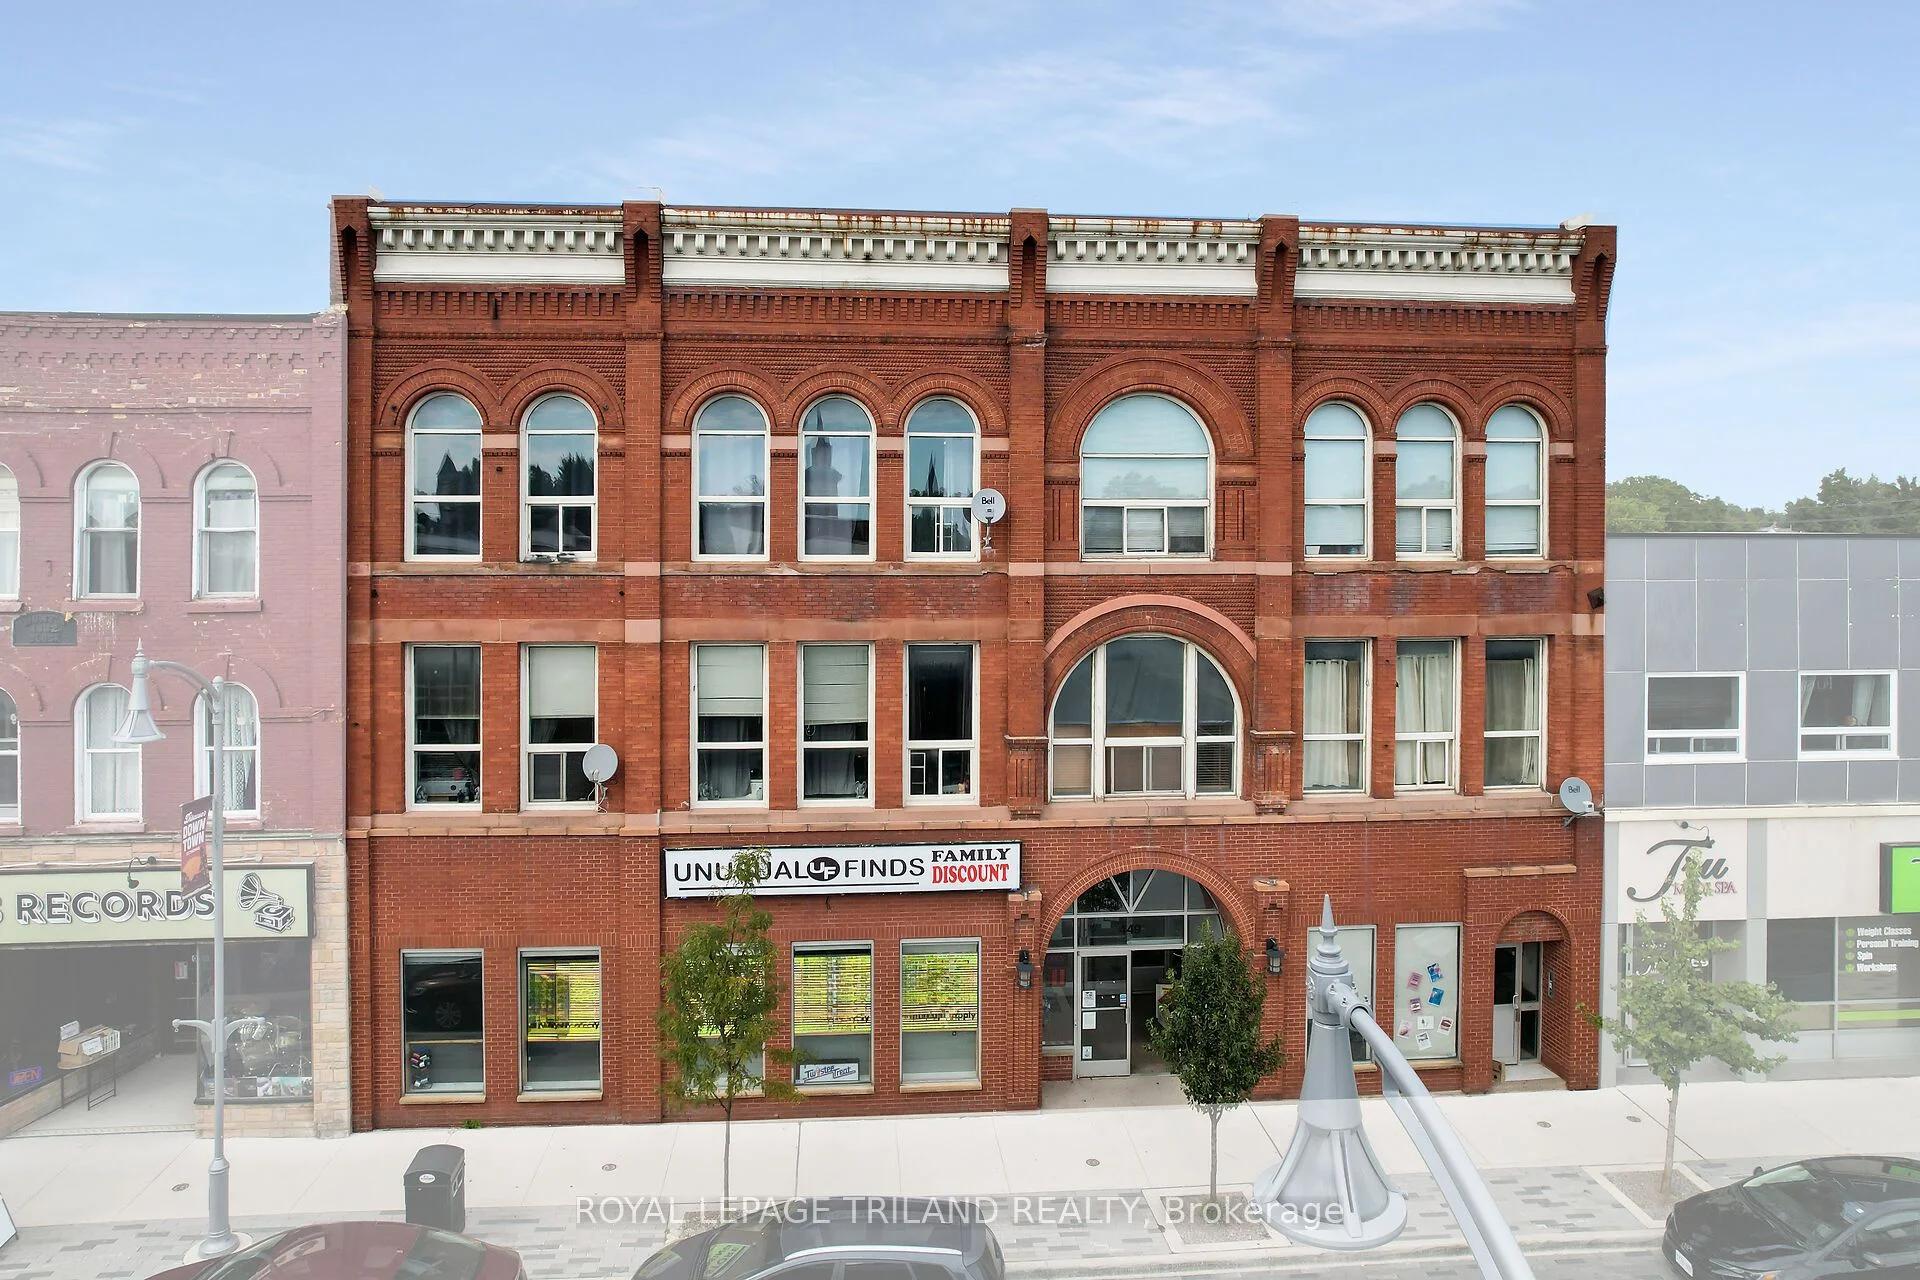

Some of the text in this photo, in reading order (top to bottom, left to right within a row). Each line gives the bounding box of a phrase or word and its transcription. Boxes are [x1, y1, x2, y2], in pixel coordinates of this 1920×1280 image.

[981, 496, 995, 505] Bell
[1568, 785, 1581, 794] Bell
[183, 817, 206, 840] DOWN
[183, 830, 205, 852] TOWN
[931, 848, 1011, 863] FAMILY
[673, 860, 809, 882] UNUUAL
[844, 858, 925, 878] FINDS
[931, 863, 1010, 884] DISCOUNT
[1714, 881, 1737, 894] SPA
[15, 889, 216, 925] RECORDS
[1857, 926, 1912, 937] Weight Classes
[1857, 938, 1919, 949] Personal Training
[1857, 951, 1873, 961] Spin
[1857, 963, 1897, 972] Workshops
